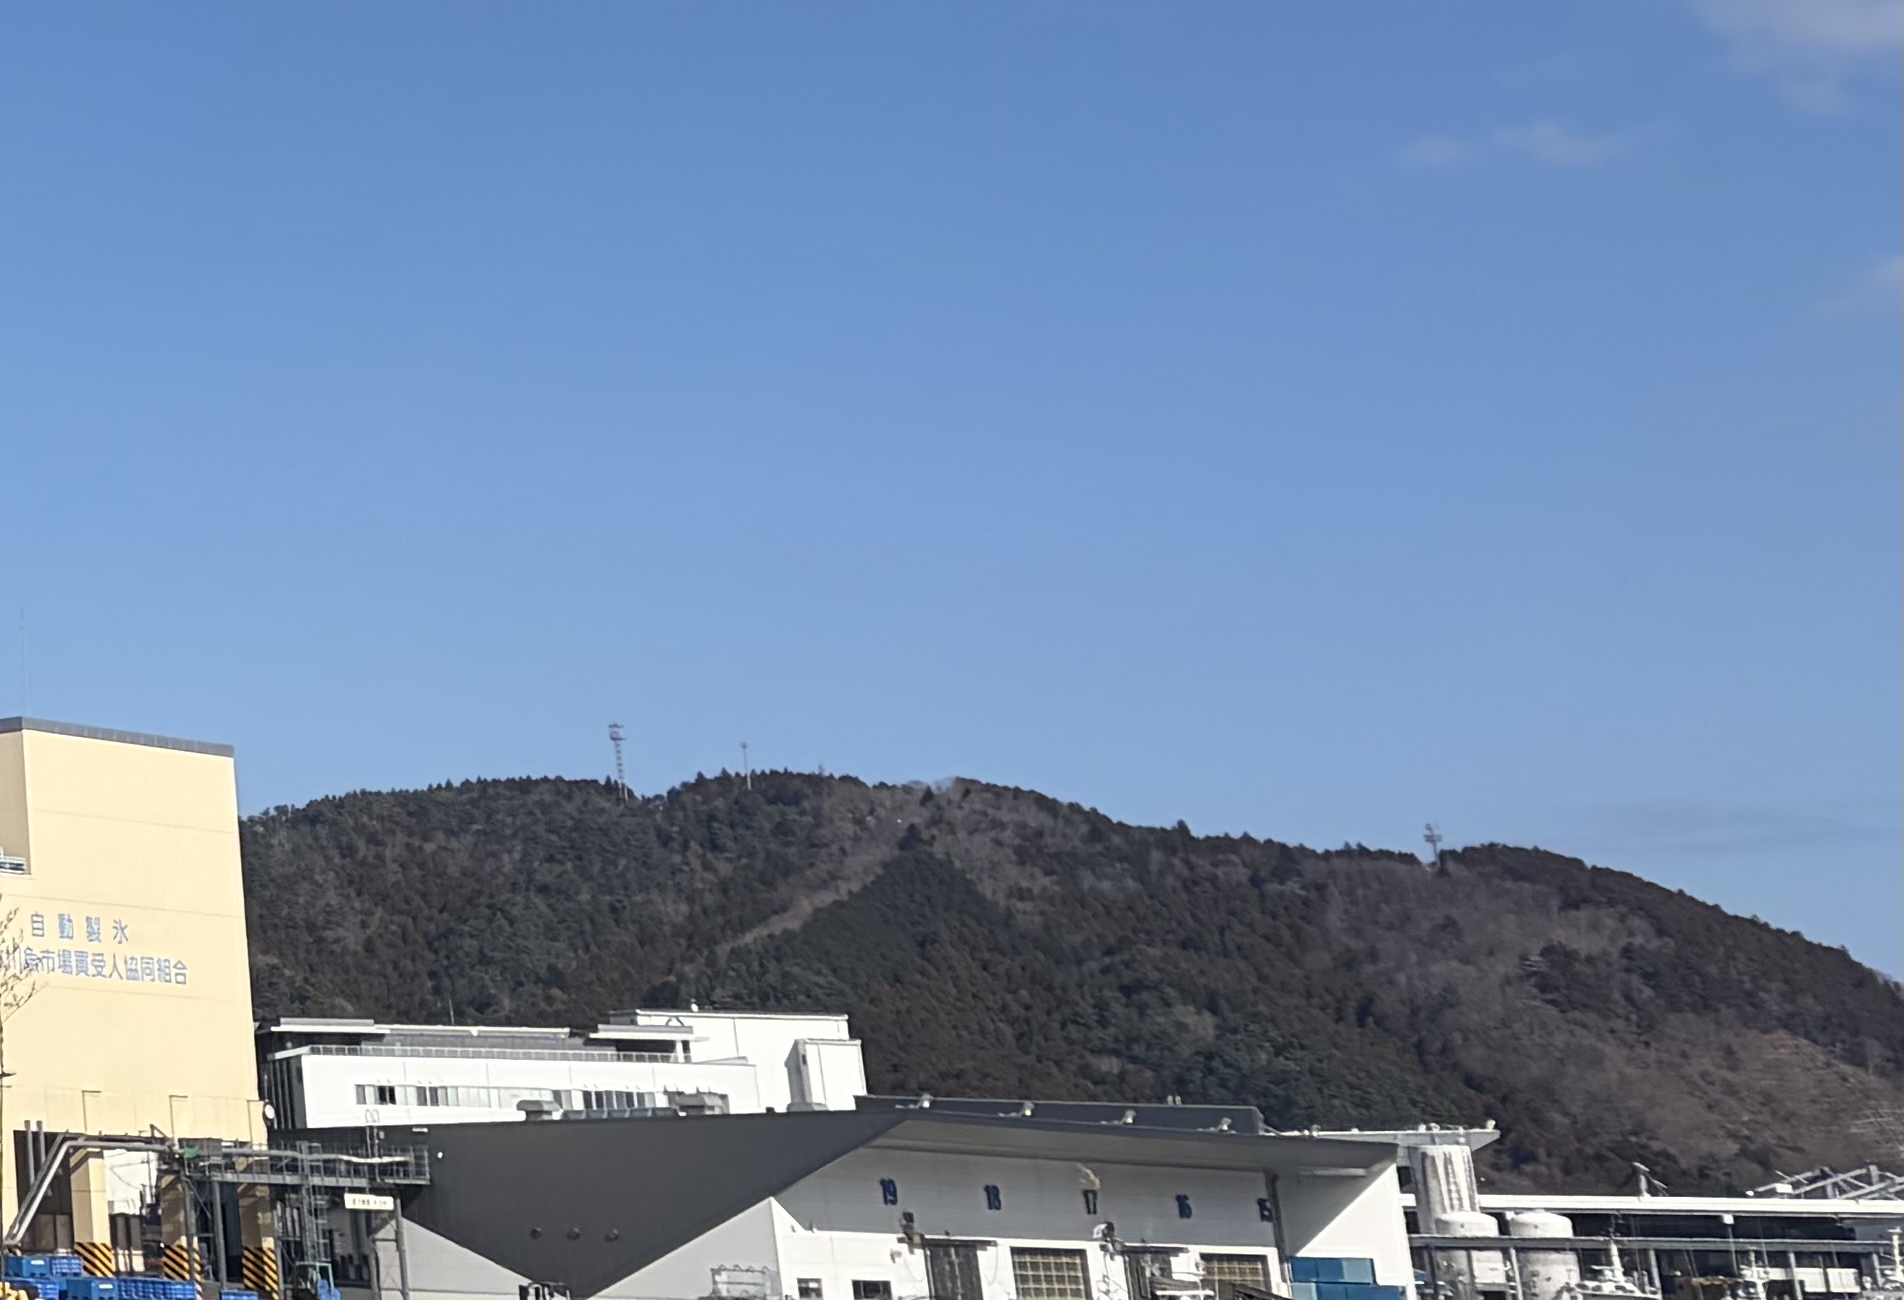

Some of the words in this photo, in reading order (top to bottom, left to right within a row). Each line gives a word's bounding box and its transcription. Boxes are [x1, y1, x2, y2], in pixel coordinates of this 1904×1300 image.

[30, 911, 129, 944] 自動製氷
[879, 1178, 898, 1206] 19
[983, 1184, 1002, 1211] 18
